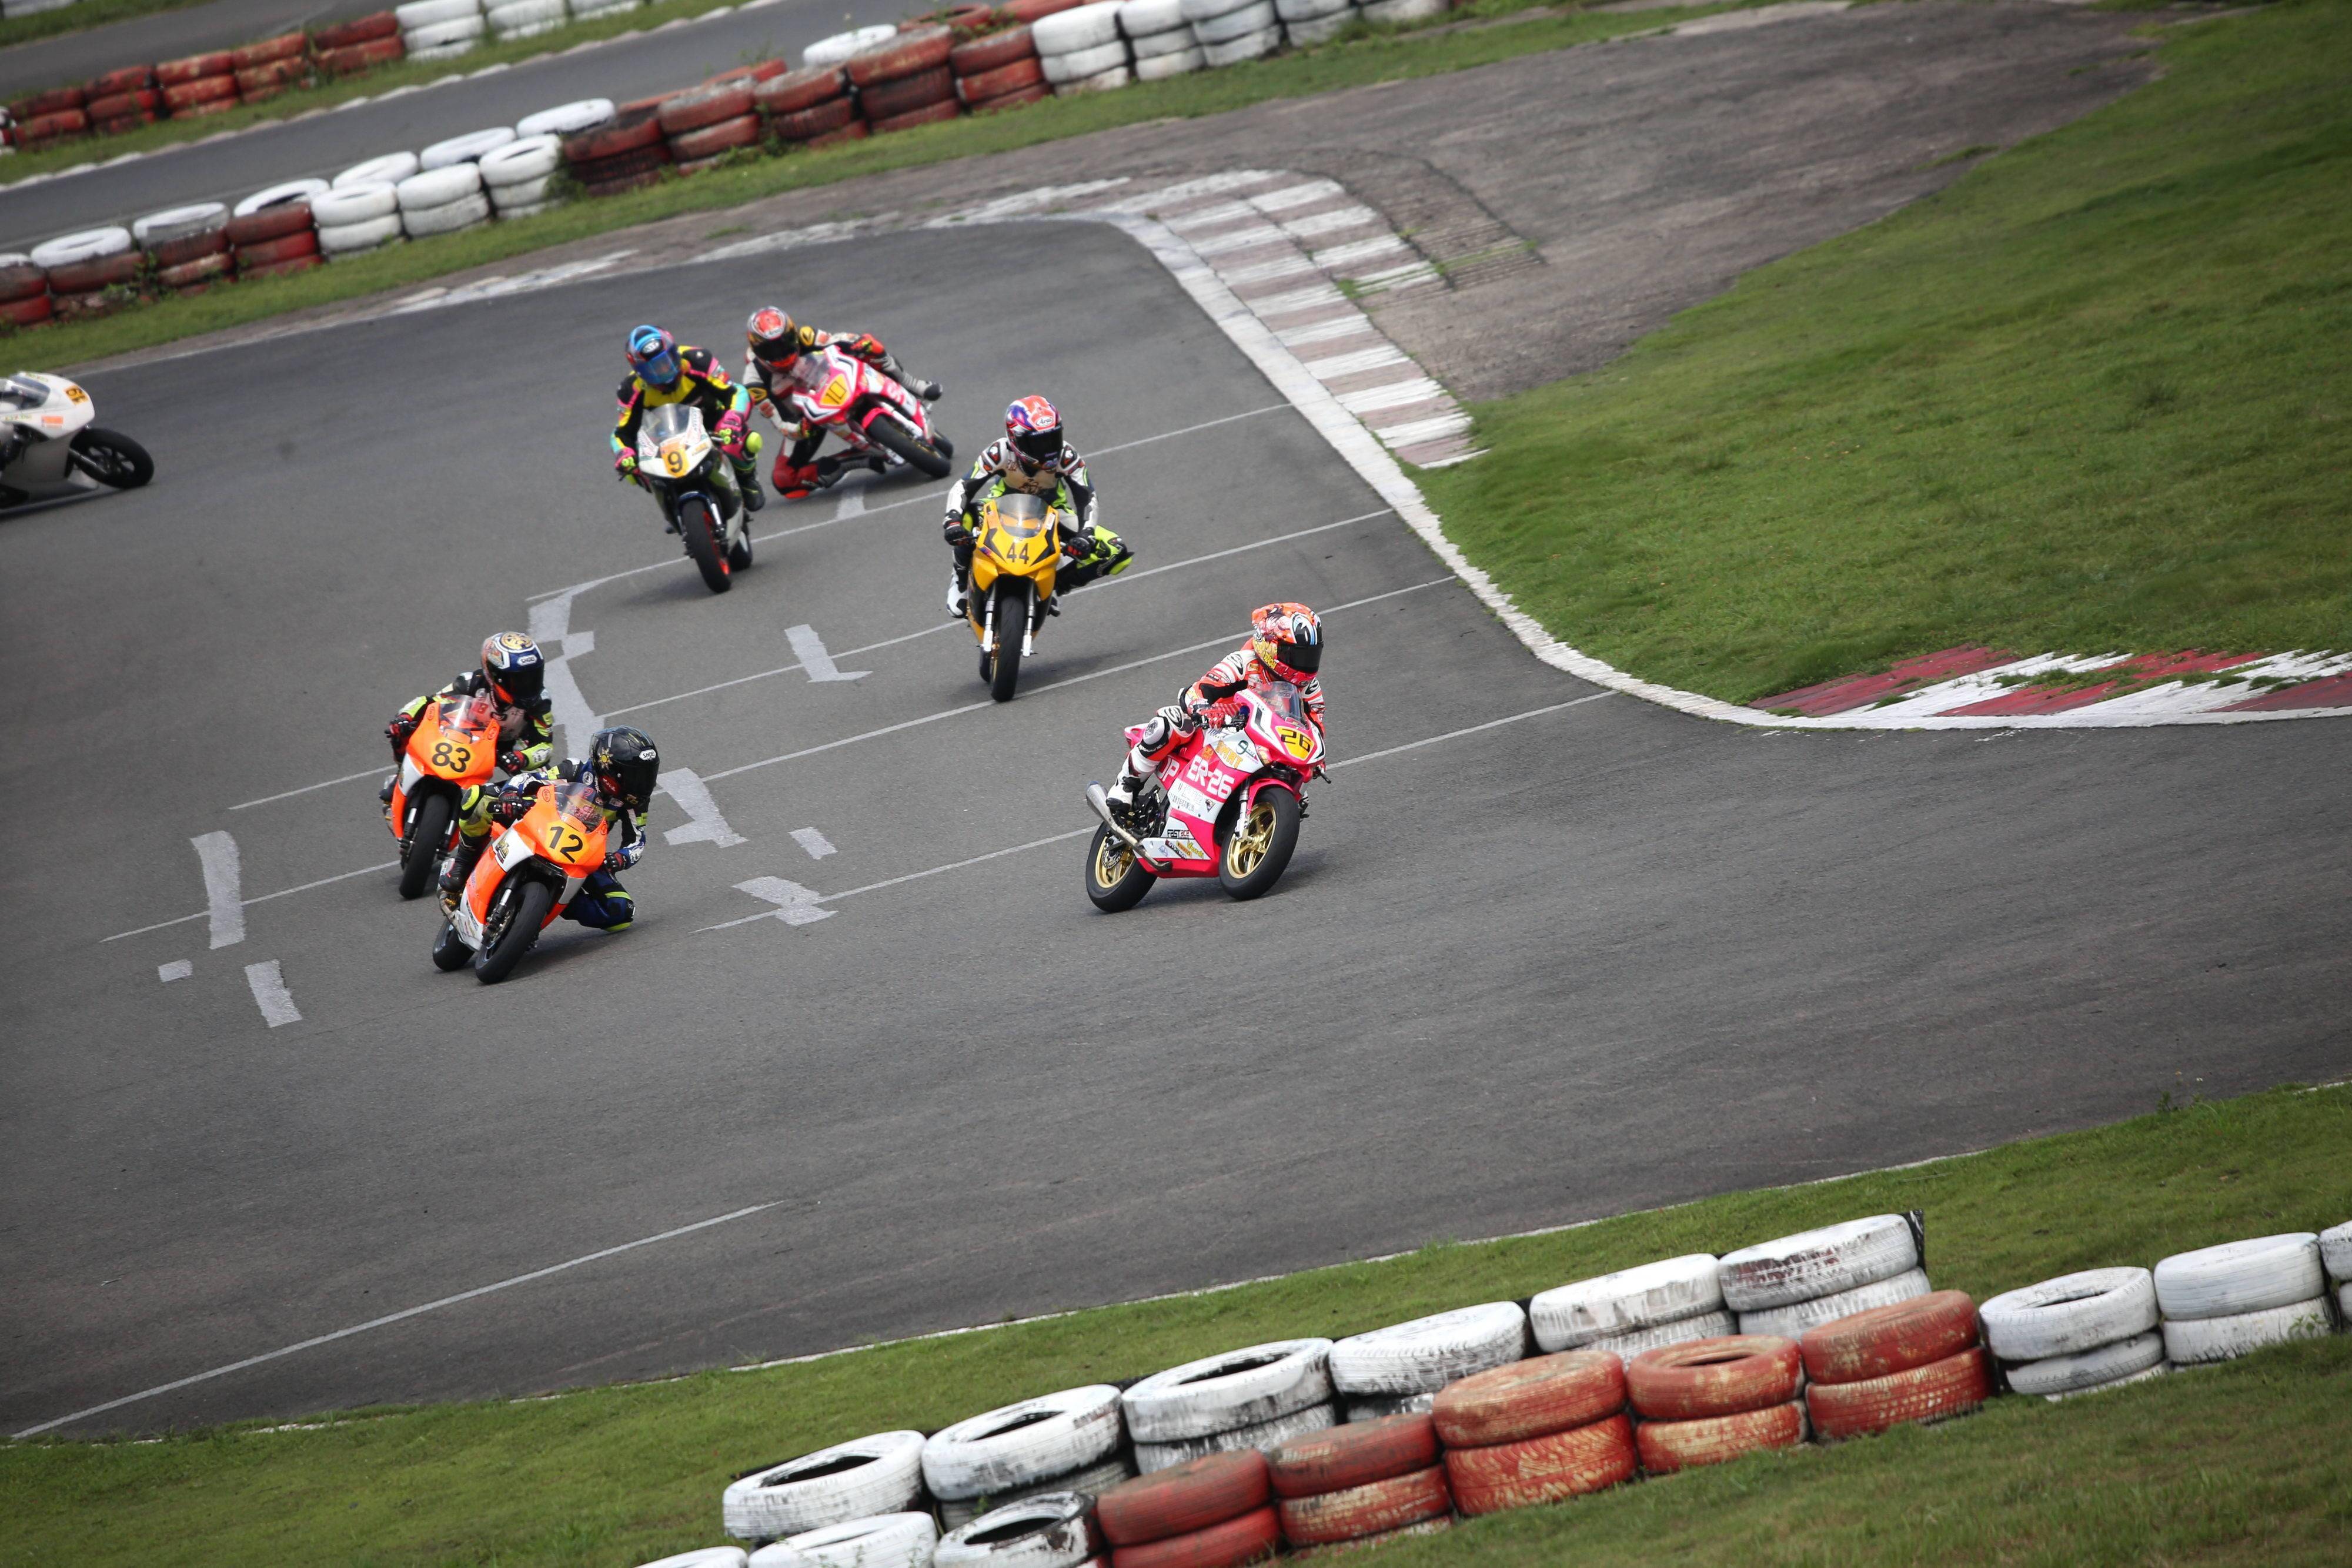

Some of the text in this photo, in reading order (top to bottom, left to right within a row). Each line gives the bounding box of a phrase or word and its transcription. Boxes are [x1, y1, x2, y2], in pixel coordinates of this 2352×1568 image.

[826, 380, 847, 404] 10
[667, 451, 683, 473] 9
[1006, 541, 1030, 564] 44
[1281, 728, 1311, 753] 26
[432, 742, 470, 773] 83
[1186, 754, 1235, 800] ER-26
[549, 826, 583, 863] 12
